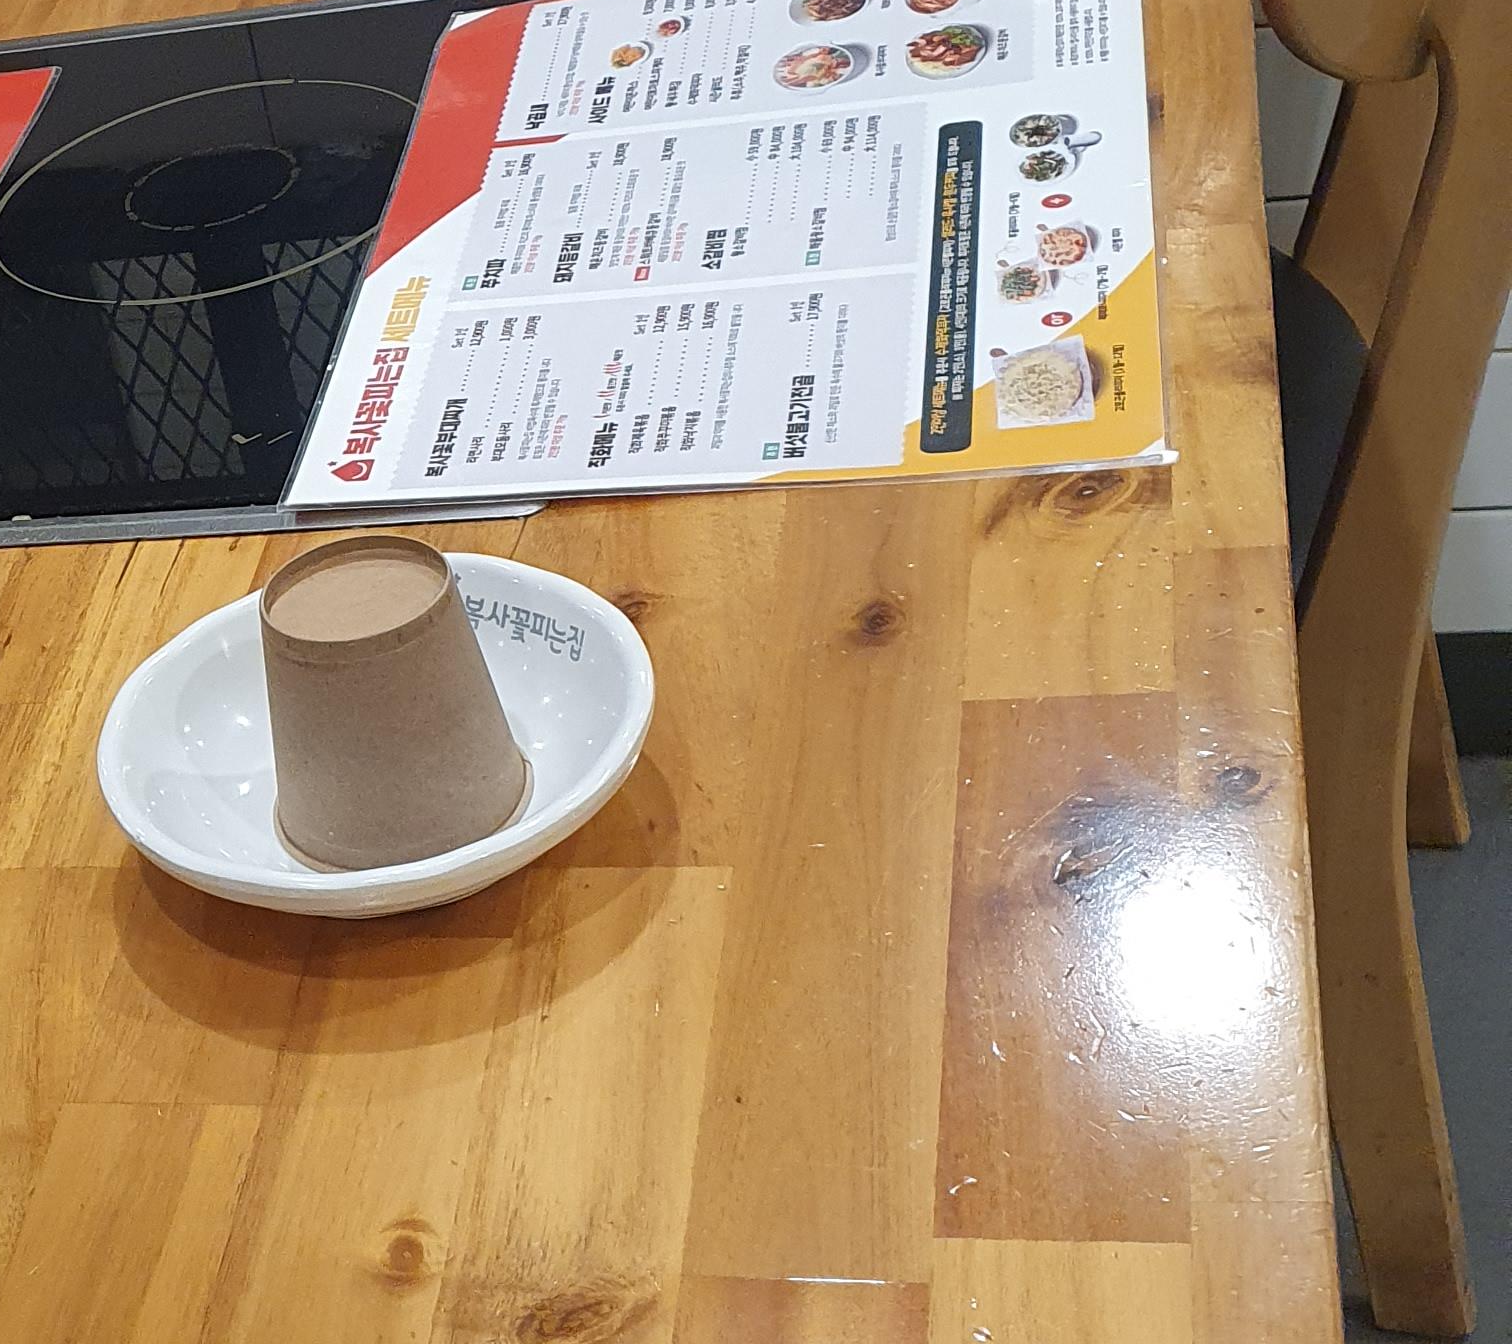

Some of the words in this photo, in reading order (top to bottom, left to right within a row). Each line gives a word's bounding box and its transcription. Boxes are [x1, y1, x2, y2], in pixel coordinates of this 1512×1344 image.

[594, 75, 615, 95] 메뉴
[524, 102, 549, 130] 낙곱새
[587, 95, 611, 123] 사이드
[552, 231, 583, 283] 돼지등갈비
[701, 228, 727, 269] 소갈비찜
[632, 323, 646, 335] Set
[1051, 312, 1066, 324] or
[450, 337, 464, 348] Set
[342, 346, 409, 454] 복사꽃피는집
[380, 275, 430, 342] 세트메뉴
[782, 374, 815, 458] 버섯불고기전골
[424, 397, 468, 476] 복사꽃부대찌개
[465, 435, 485, 463] 라면사리
[587, 421, 618, 467] 직화메뉴
[464, 595, 586, 662] 복사꽃피는집
